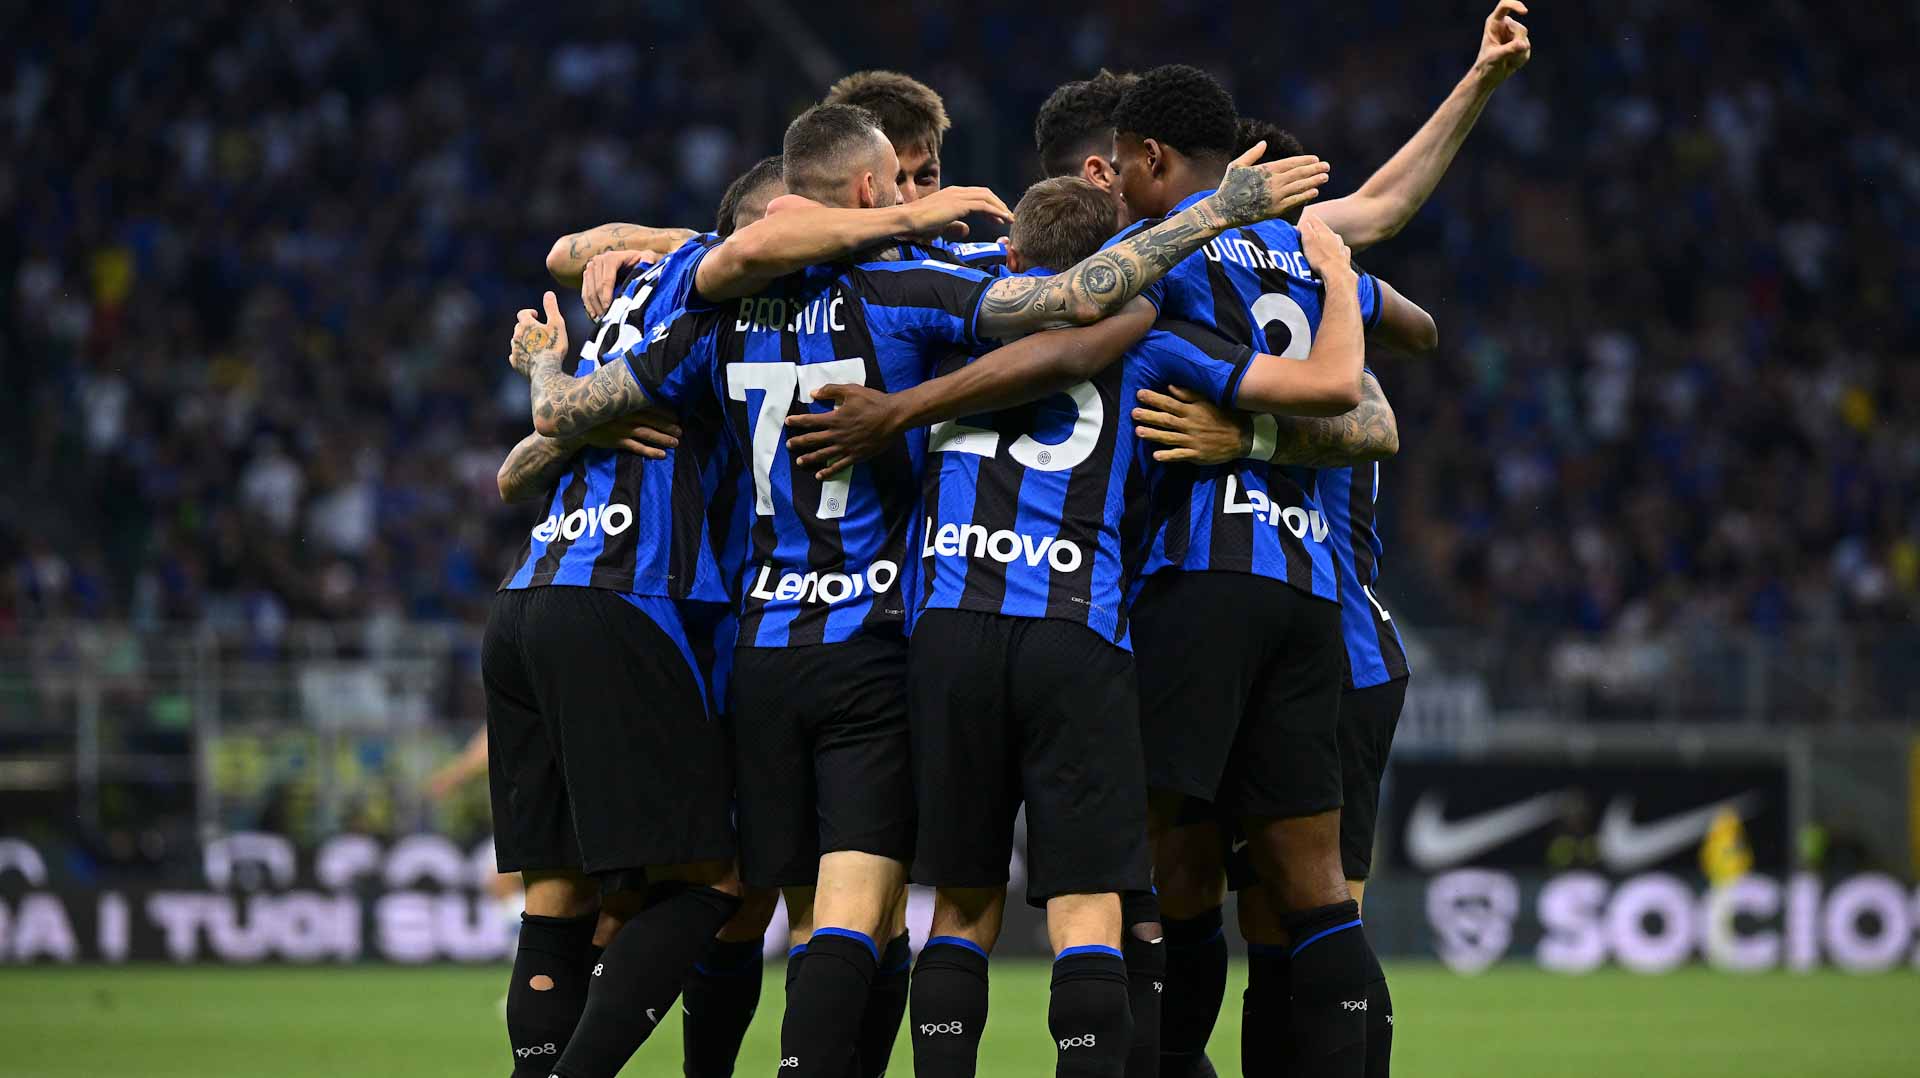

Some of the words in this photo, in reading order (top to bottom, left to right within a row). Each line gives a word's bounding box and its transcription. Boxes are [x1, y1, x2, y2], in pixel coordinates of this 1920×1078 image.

[726, 356, 867, 520] 77
[531, 503, 633, 543] enovo
[1223, 473, 1329, 543] Lenov
[922, 516, 1083, 574] Lenovo
[750, 559, 898, 605] Lenovo
[920, 1021, 963, 1036] 1908
[1059, 1033, 1096, 1050] 1908
[515, 1042, 557, 1059] 1908
[780, 1056, 799, 1068] 08
